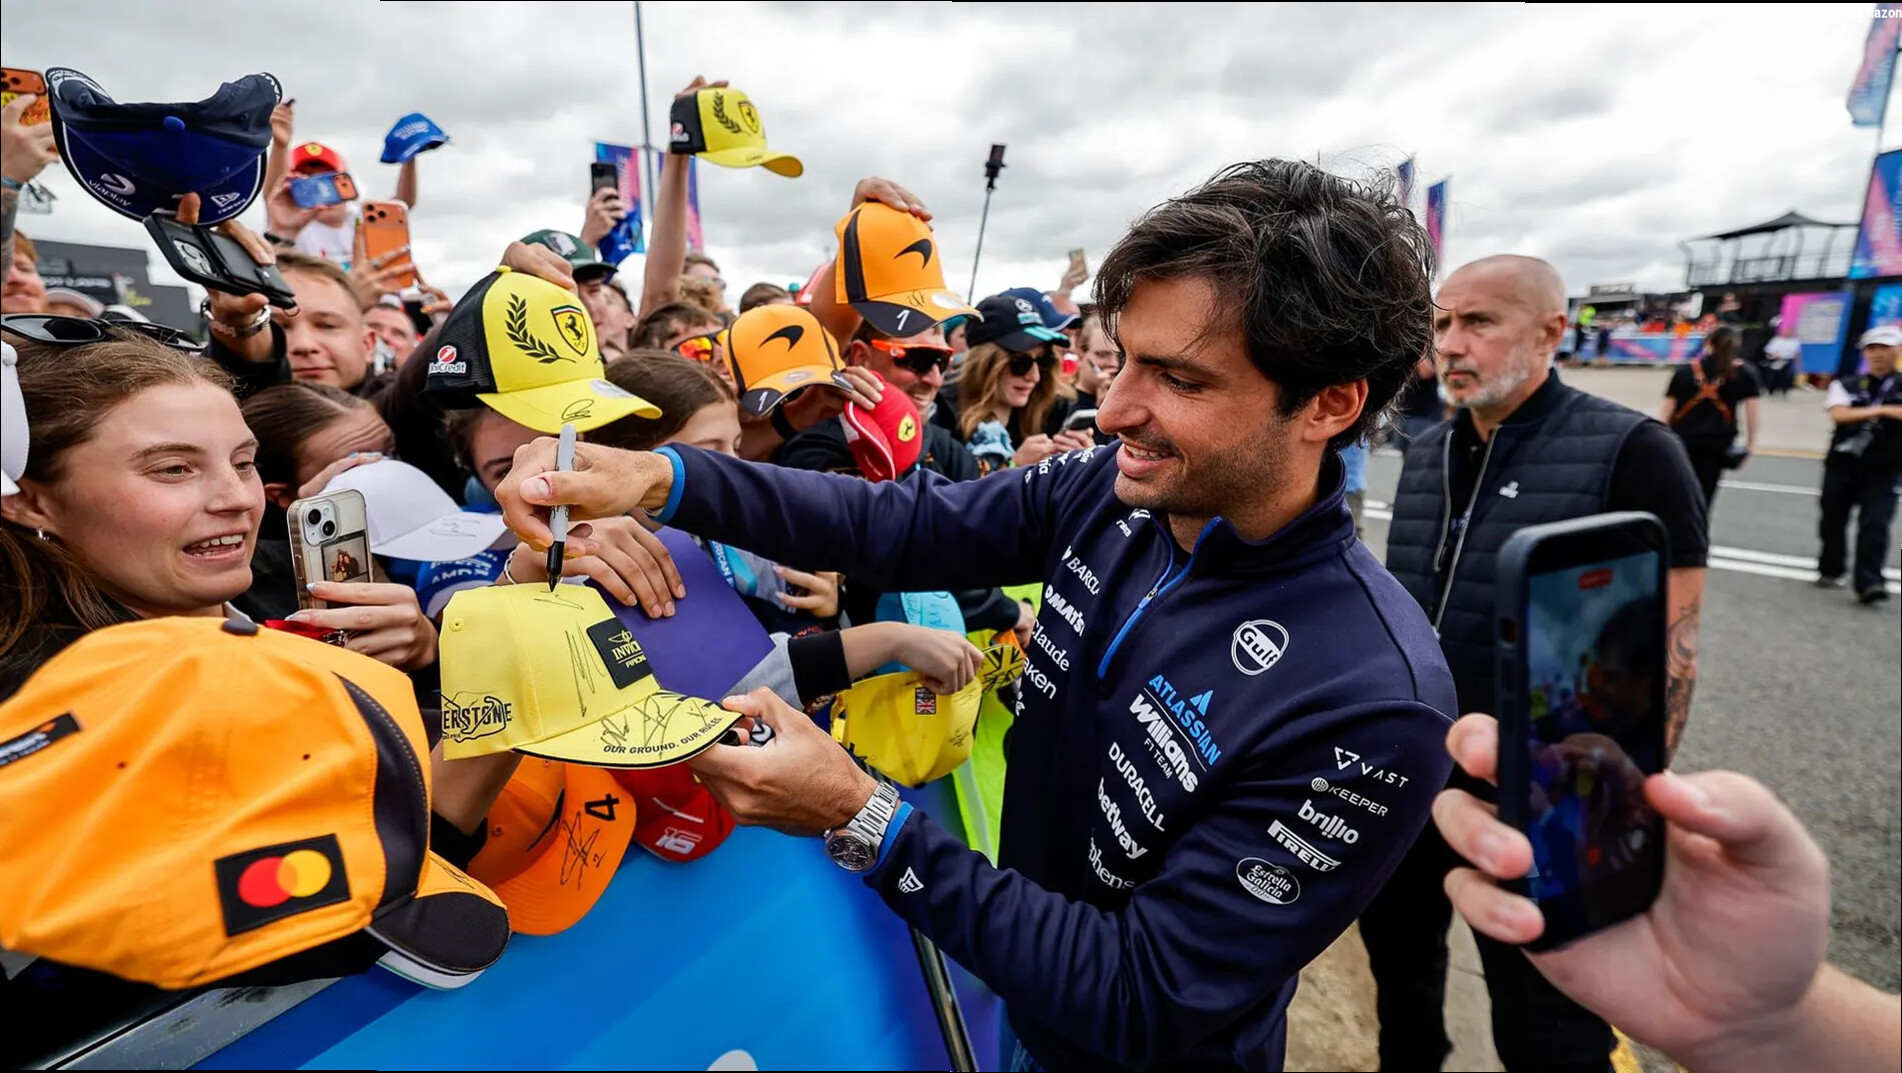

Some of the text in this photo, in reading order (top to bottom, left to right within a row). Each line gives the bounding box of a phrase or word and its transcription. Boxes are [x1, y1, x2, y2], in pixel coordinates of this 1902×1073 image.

[1239, 627, 1278, 665] Gulf
[1023, 656, 1057, 700] aken
[1149, 674, 1221, 766] ATLASSIAN
[603, 745, 627, 754] OUR
[629, 742, 680, 754] GROUND.
[680, 732, 701, 745] OUR
[1129, 693, 1198, 793] Williams
[1143, 737, 1174, 779] F1 TEAM
[1108, 741, 1165, 832] DURACELL
[1361, 762, 1409, 788] VAST
[584, 793, 620, 821] 4
[1098, 776, 1148, 860] betway
[1328, 786, 1389, 817] KEEPER
[655, 827, 703, 855] 16
[1267, 819, 1342, 873] PIRELLI
[1246, 871, 1283, 898] Galicia
[1250, 864, 1292, 892] Estrella
